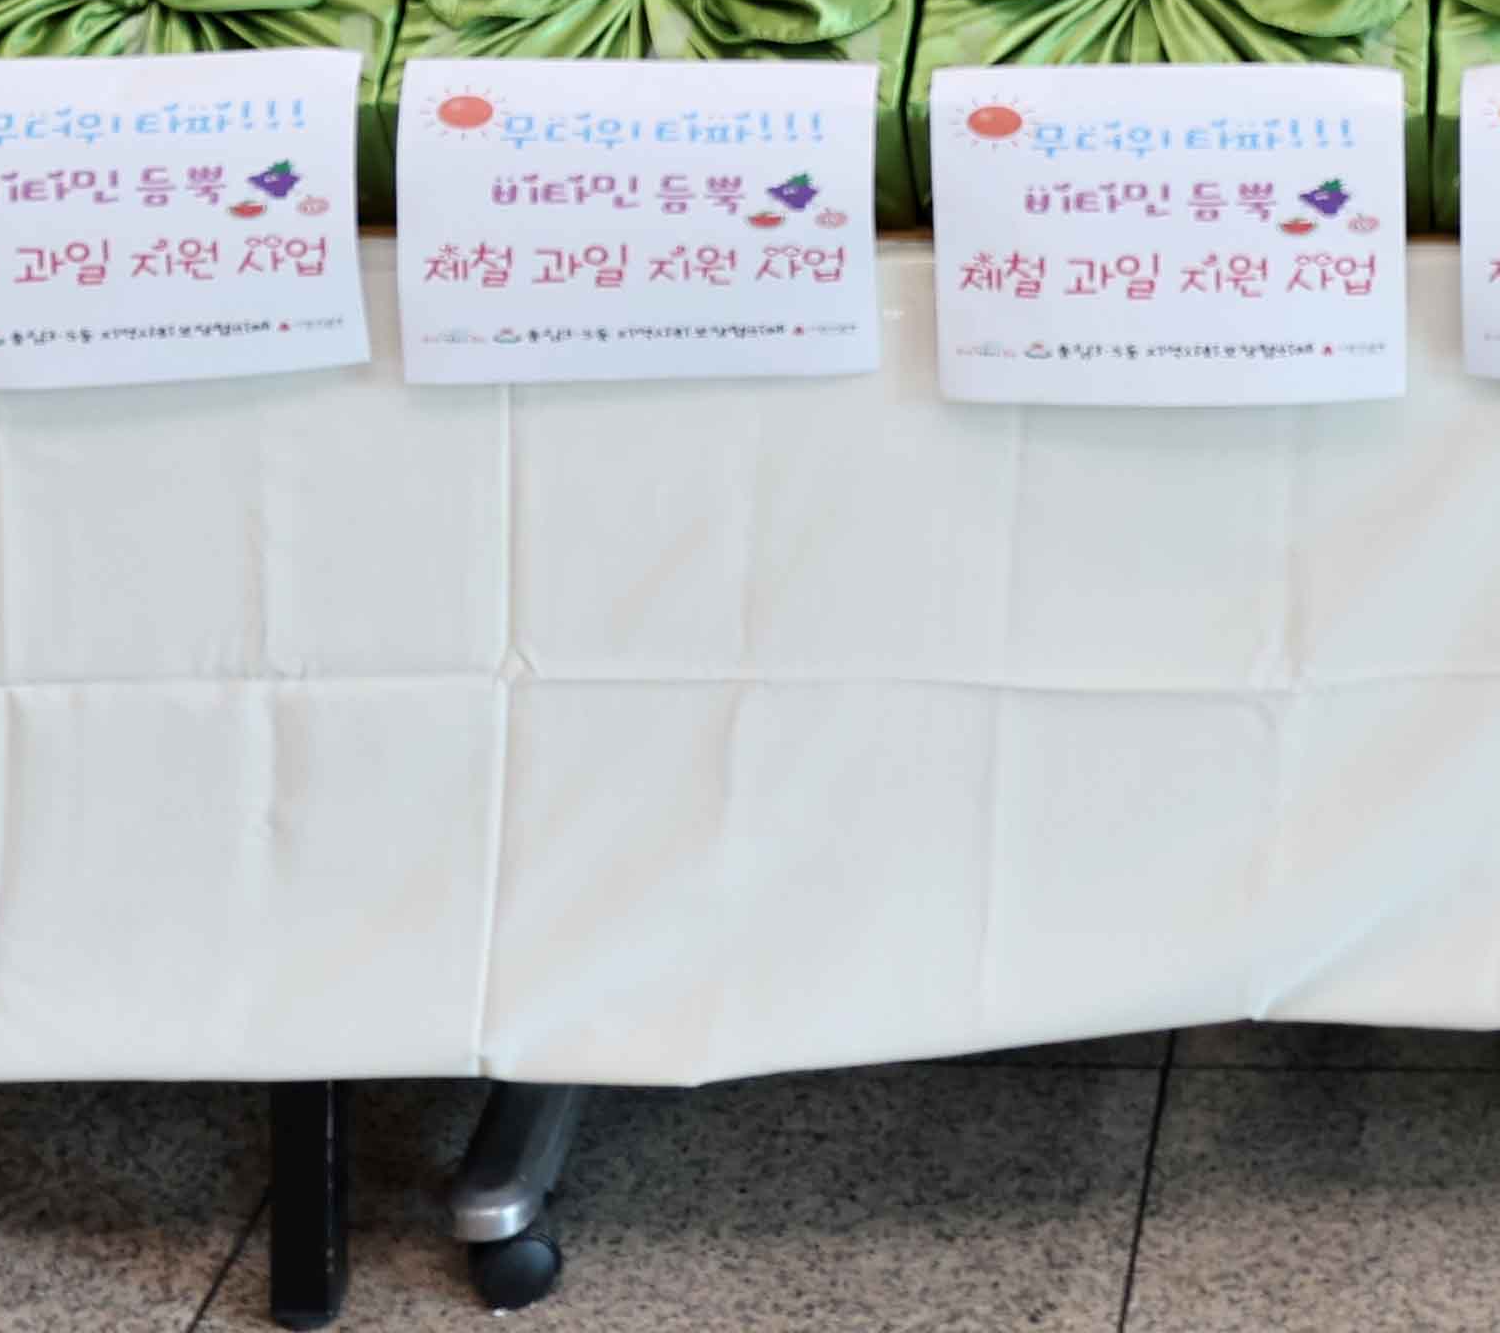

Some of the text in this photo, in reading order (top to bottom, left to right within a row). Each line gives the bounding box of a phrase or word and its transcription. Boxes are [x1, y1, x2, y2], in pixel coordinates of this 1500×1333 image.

[134, 99, 307, 137] 타파!!!
[499, 111, 827, 151] 무더위 타파!!!
[1029, 117, 1357, 160] 무더위 타파!!!
[490, 174, 641, 209] 비타민
[1023, 182, 1171, 218] 비타민
[12, 239, 111, 287] 과일
[130, 236, 220, 280] 지원
[236, 235, 329, 279] 사업
[422, 241, 848, 290] 제철 과일 지원 사업
[958, 251, 1378, 301] 제철 과일 지원 사업
